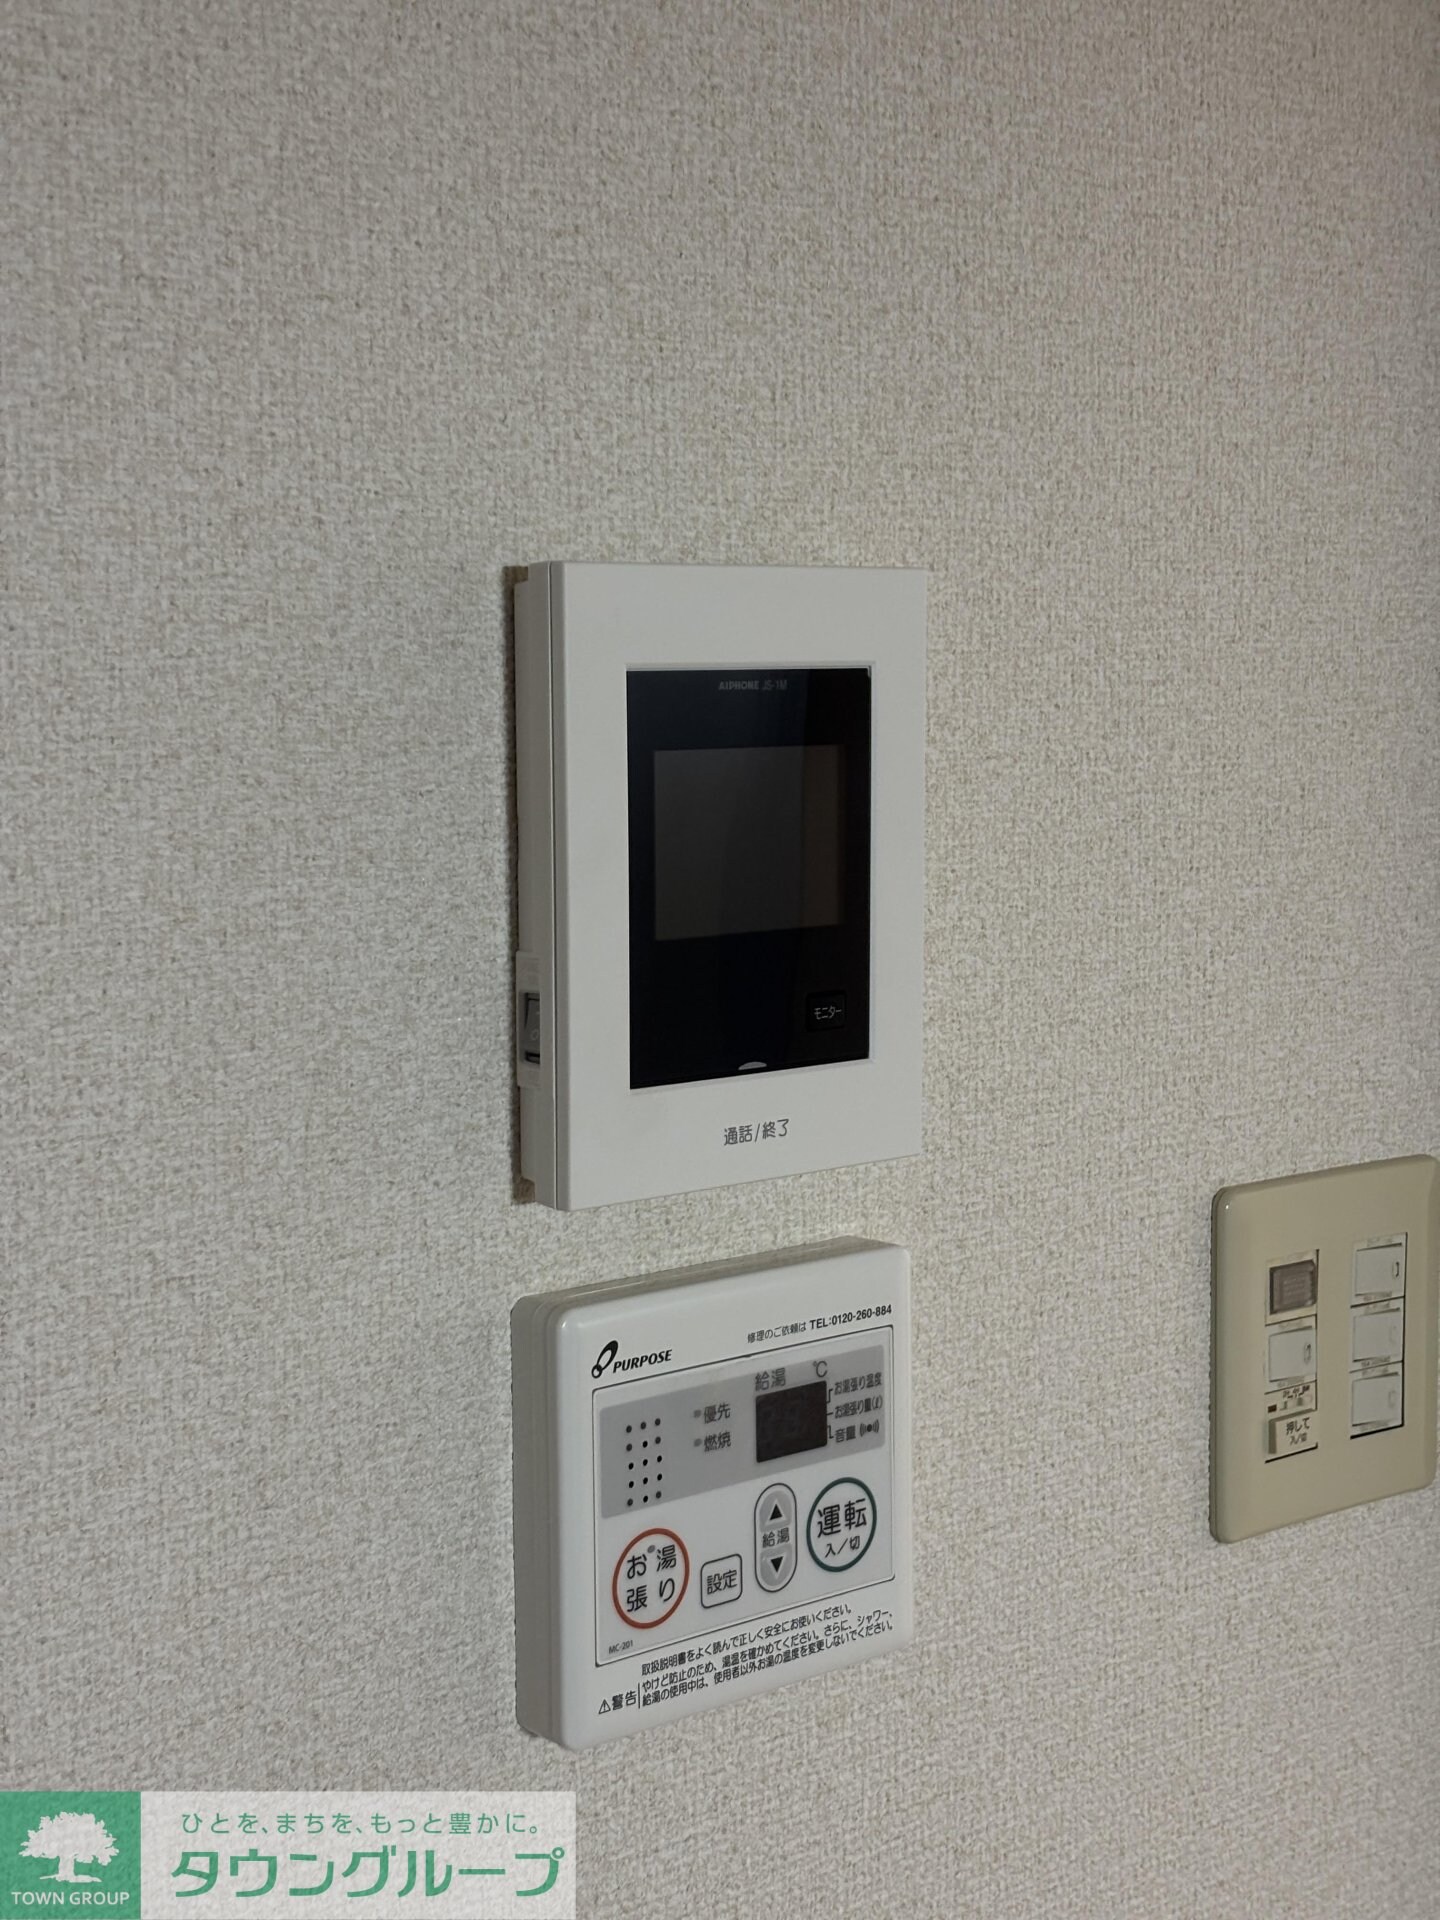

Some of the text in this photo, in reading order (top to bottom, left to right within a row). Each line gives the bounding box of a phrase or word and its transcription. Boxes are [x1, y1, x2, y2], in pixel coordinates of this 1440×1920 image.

[719, 680, 759, 690] AIPHONE
[814, 1005, 842, 1020] モニター
[723, 1118, 790, 1146] 通話/終了
[747, 1304, 892, 1344] 修理のご依頼は TEL:0120-260-884
[612, 1349, 672, 1373] PURPOSE
[754, 1367, 786, 1392] 給湯
[703, 1402, 731, 1425] 優先
[703, 1431, 732, 1453] 燃焼
[835, 1425, 857, 1443] 音量
[816, 1498, 868, 1539] 運転
[762, 1528, 790, 1549] 給湯
[706, 1569, 738, 1595] 設定
[608, 1639, 634, 1654] MC-201
[611, 1690, 638, 1711] 警告
